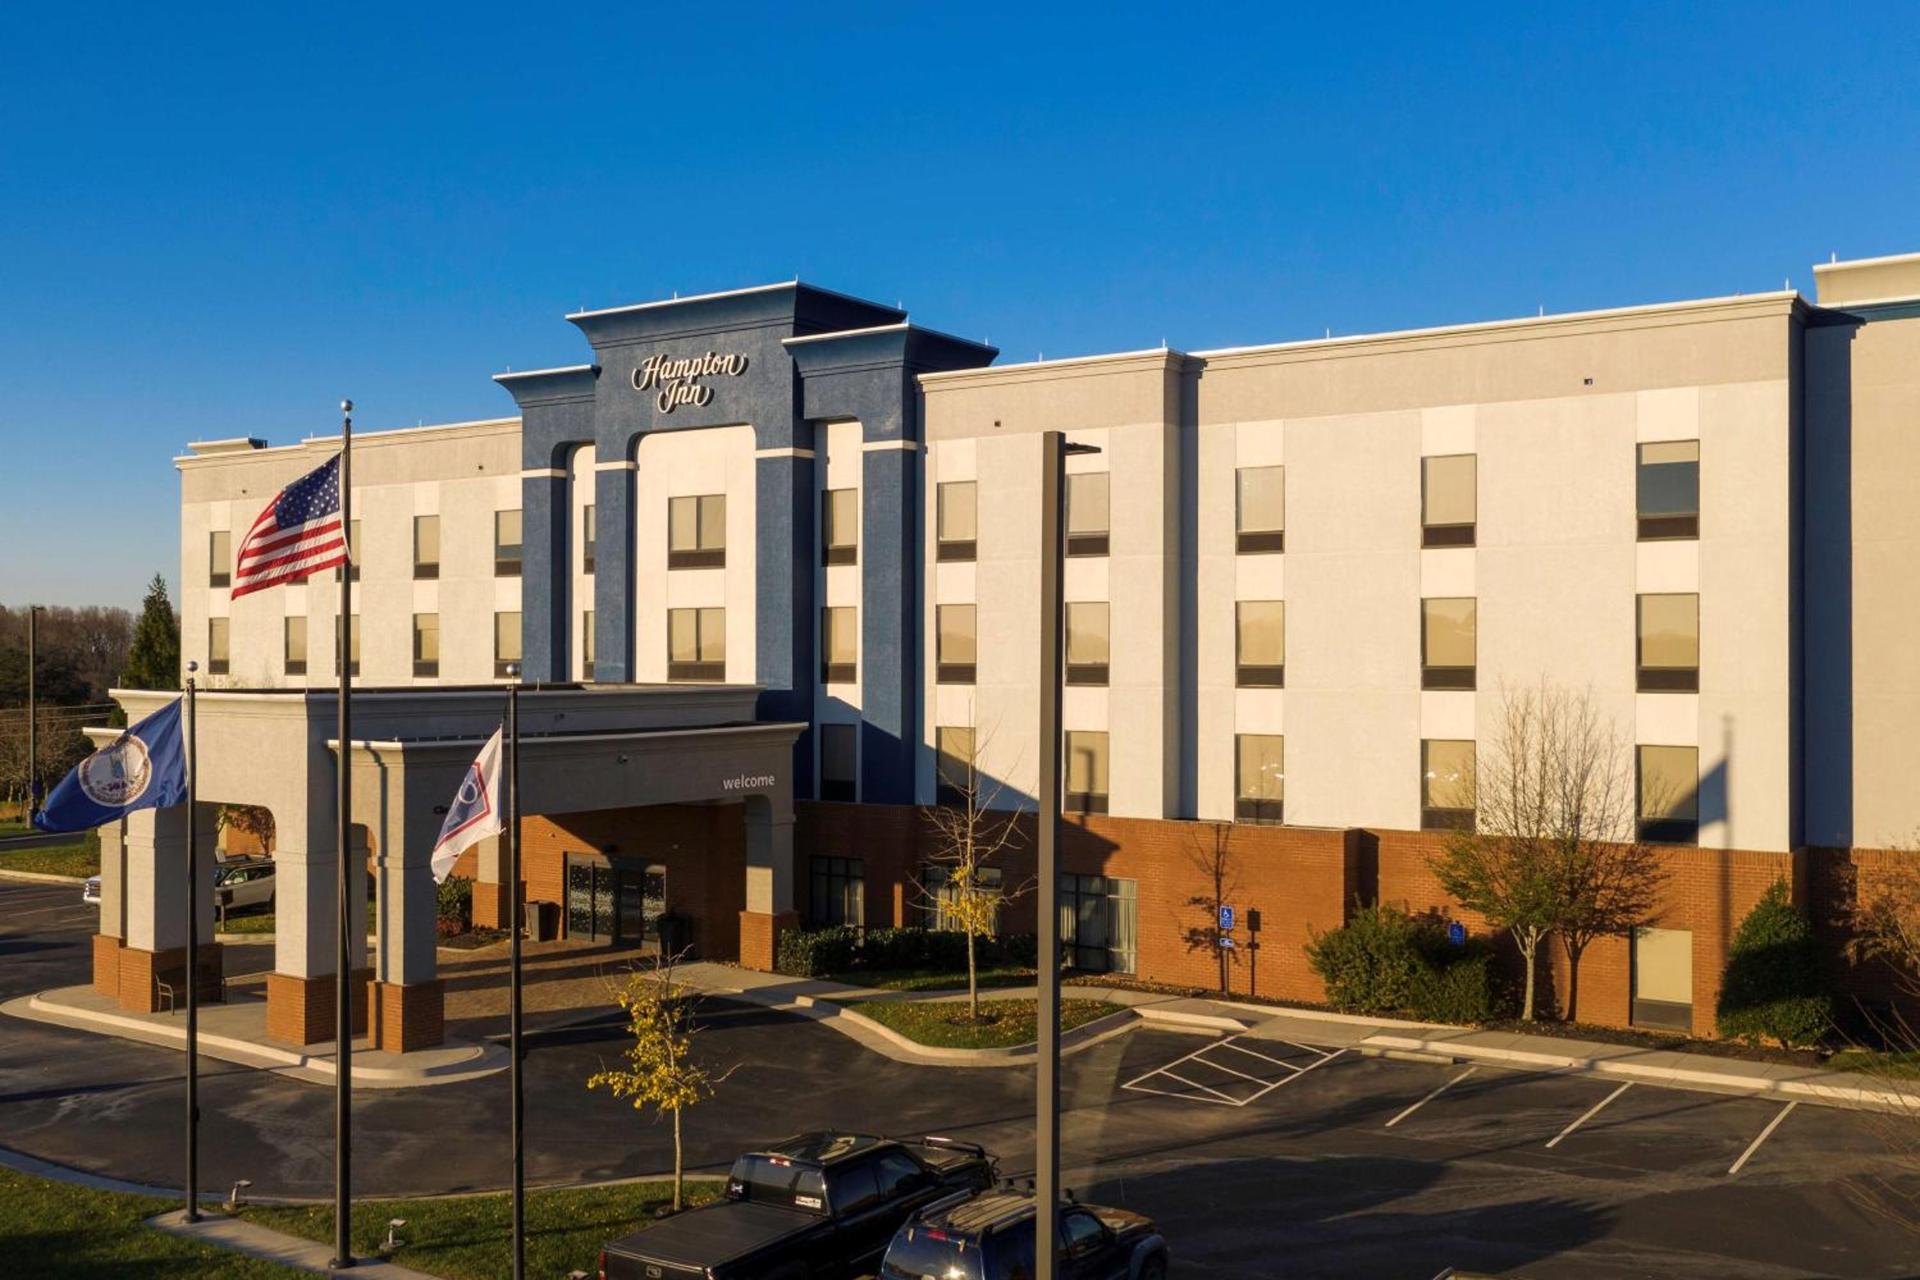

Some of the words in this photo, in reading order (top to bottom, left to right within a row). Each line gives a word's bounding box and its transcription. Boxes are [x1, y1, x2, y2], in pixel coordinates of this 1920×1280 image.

[631, 352, 748, 390] Hampton
[657, 380, 713, 414] Inn
[722, 774, 776, 790] welcome
